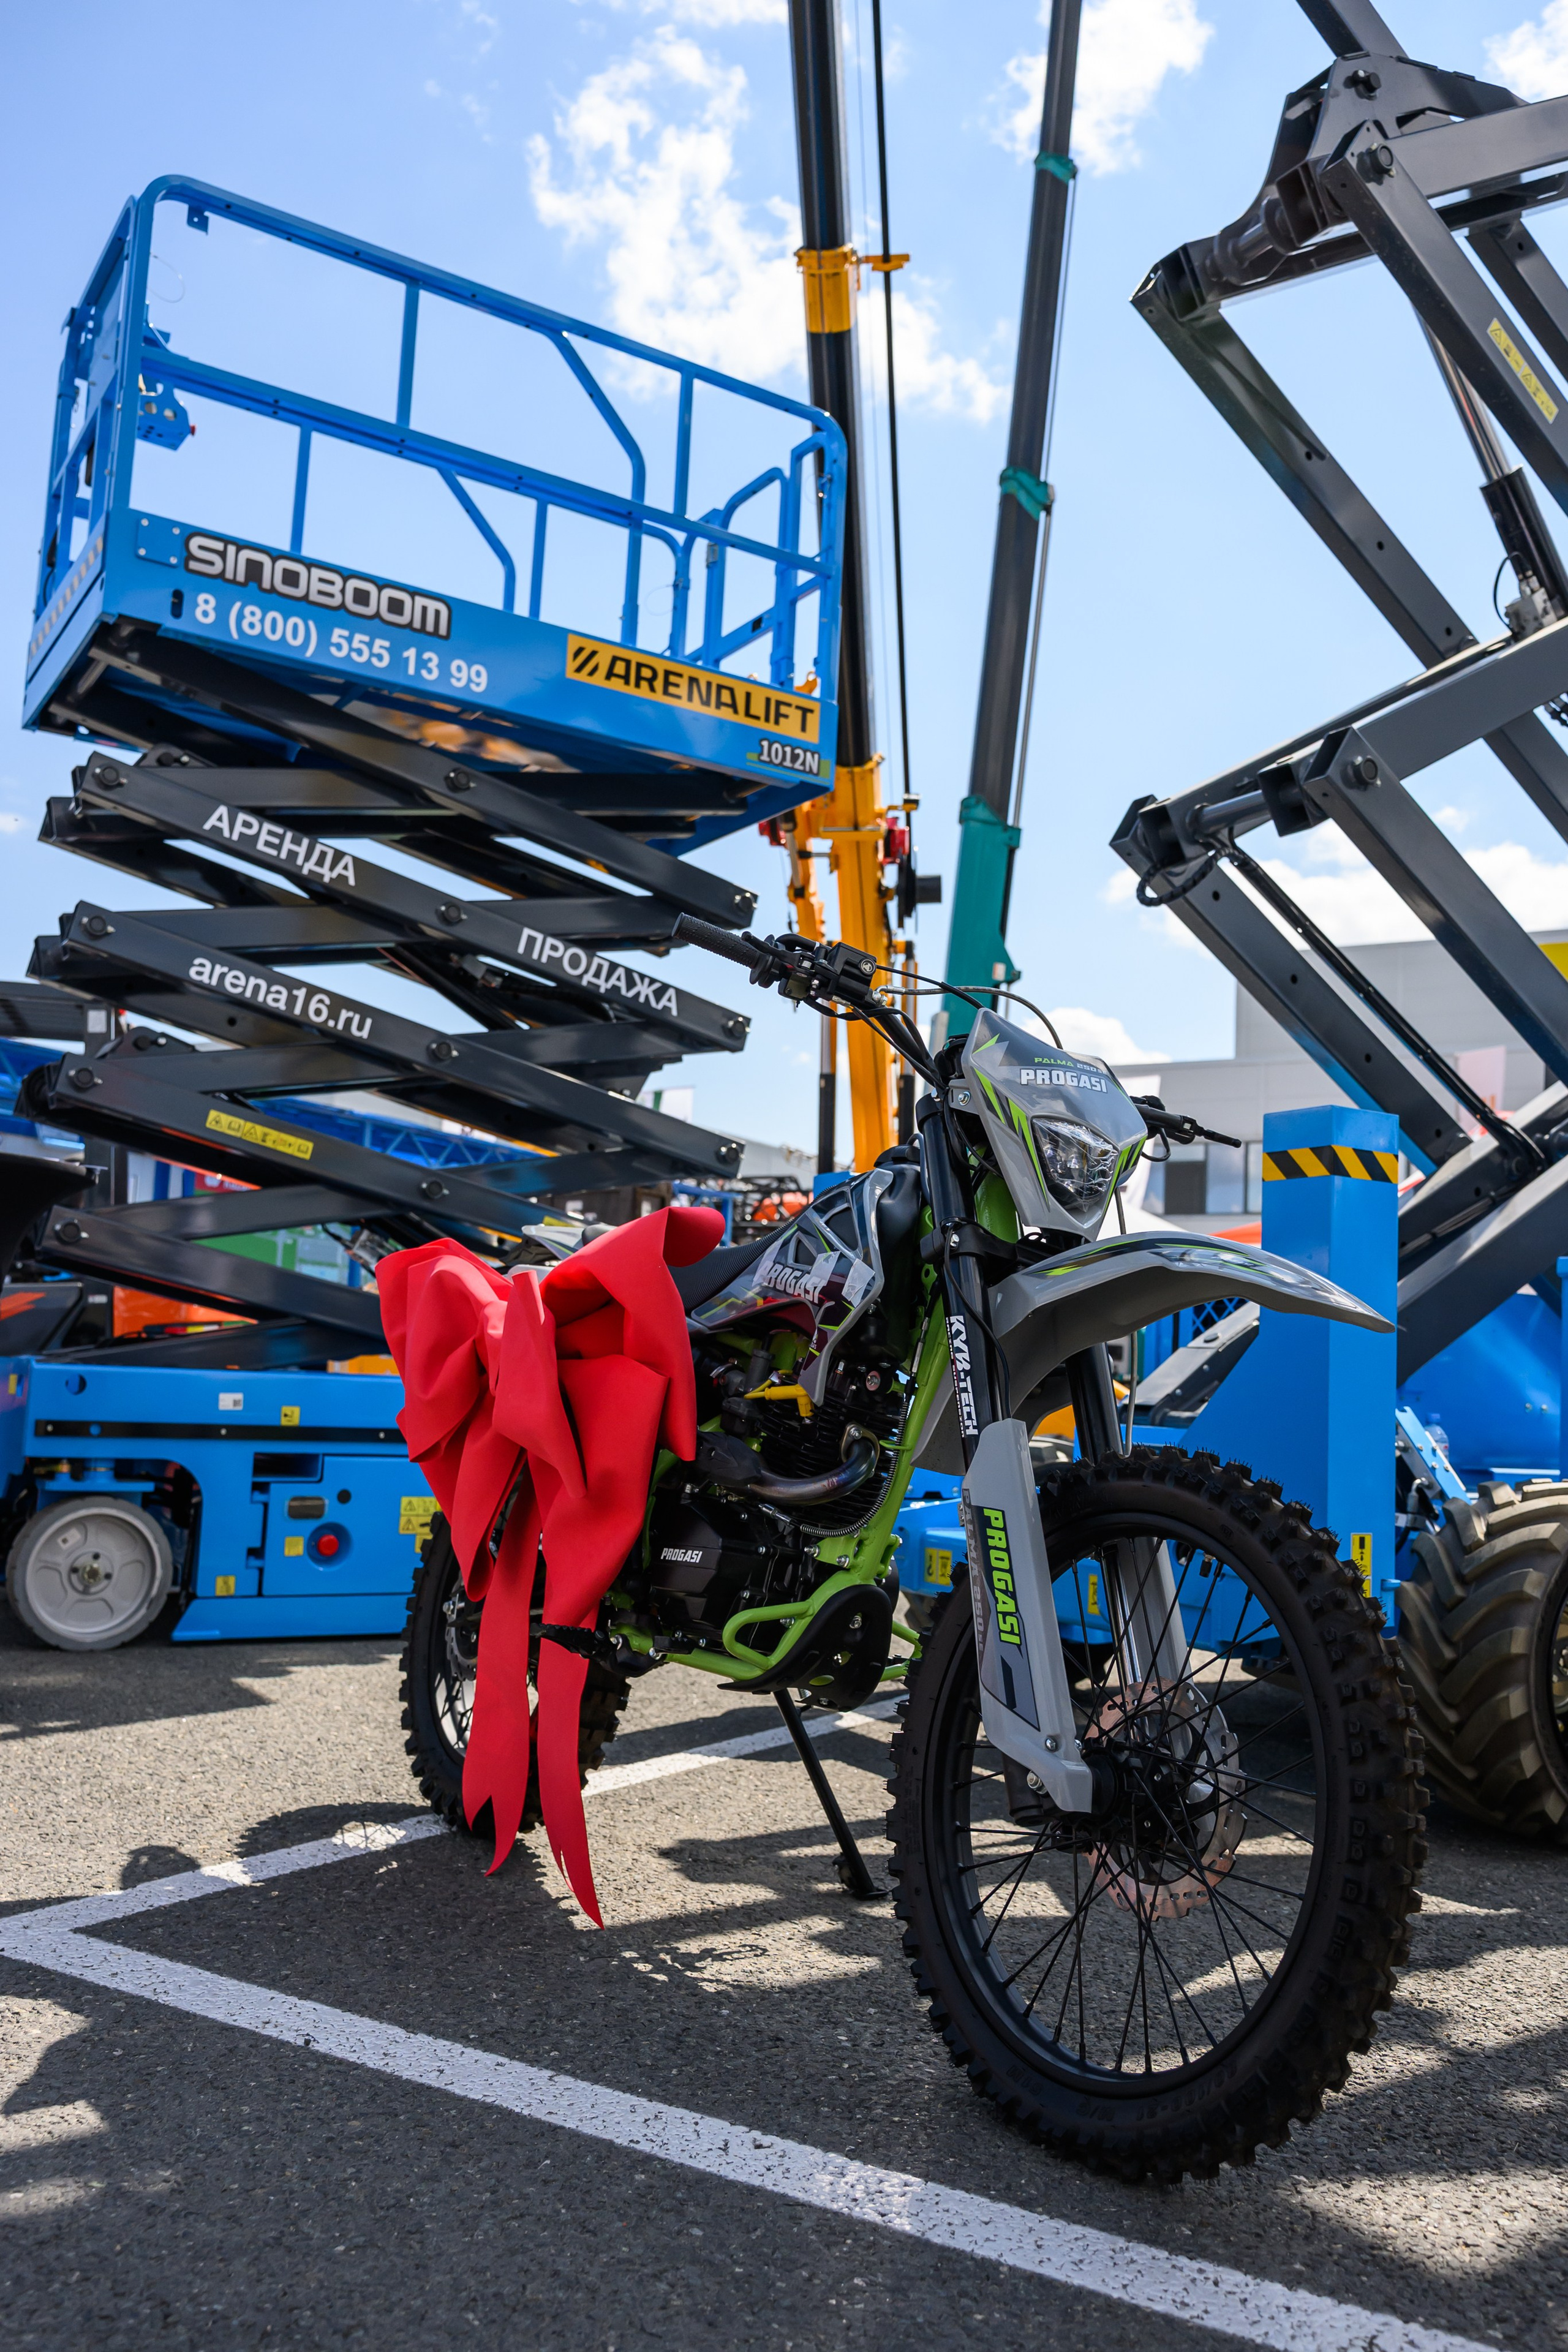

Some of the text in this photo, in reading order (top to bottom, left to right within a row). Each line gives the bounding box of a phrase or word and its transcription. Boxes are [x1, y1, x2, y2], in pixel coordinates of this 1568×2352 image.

[186, 533, 451, 639] SINOBOOM
[195, 592, 488, 693] 8 (800) 555 13 99
[605, 655, 814, 733] ARENALIFT
[760, 739, 820, 775] 1012N
[202, 804, 356, 887] АРЕНДА
[189, 957, 373, 1039] arena16.ru
[517, 927, 678, 1017] ПРОДАЖА
[1020, 1068, 1108, 1094] PROGASI
[1034, 1057, 1074, 1067] PALMA
[1076, 1063, 1097, 1072] 250
[950, 1316, 979, 1435] KYB-TECH
[660, 1548, 703, 1563] PROGASI
[962, 1489, 979, 1578] PALMA
[973, 1585, 984, 1632] 250
[983, 1508, 1021, 1645] PROGASI
